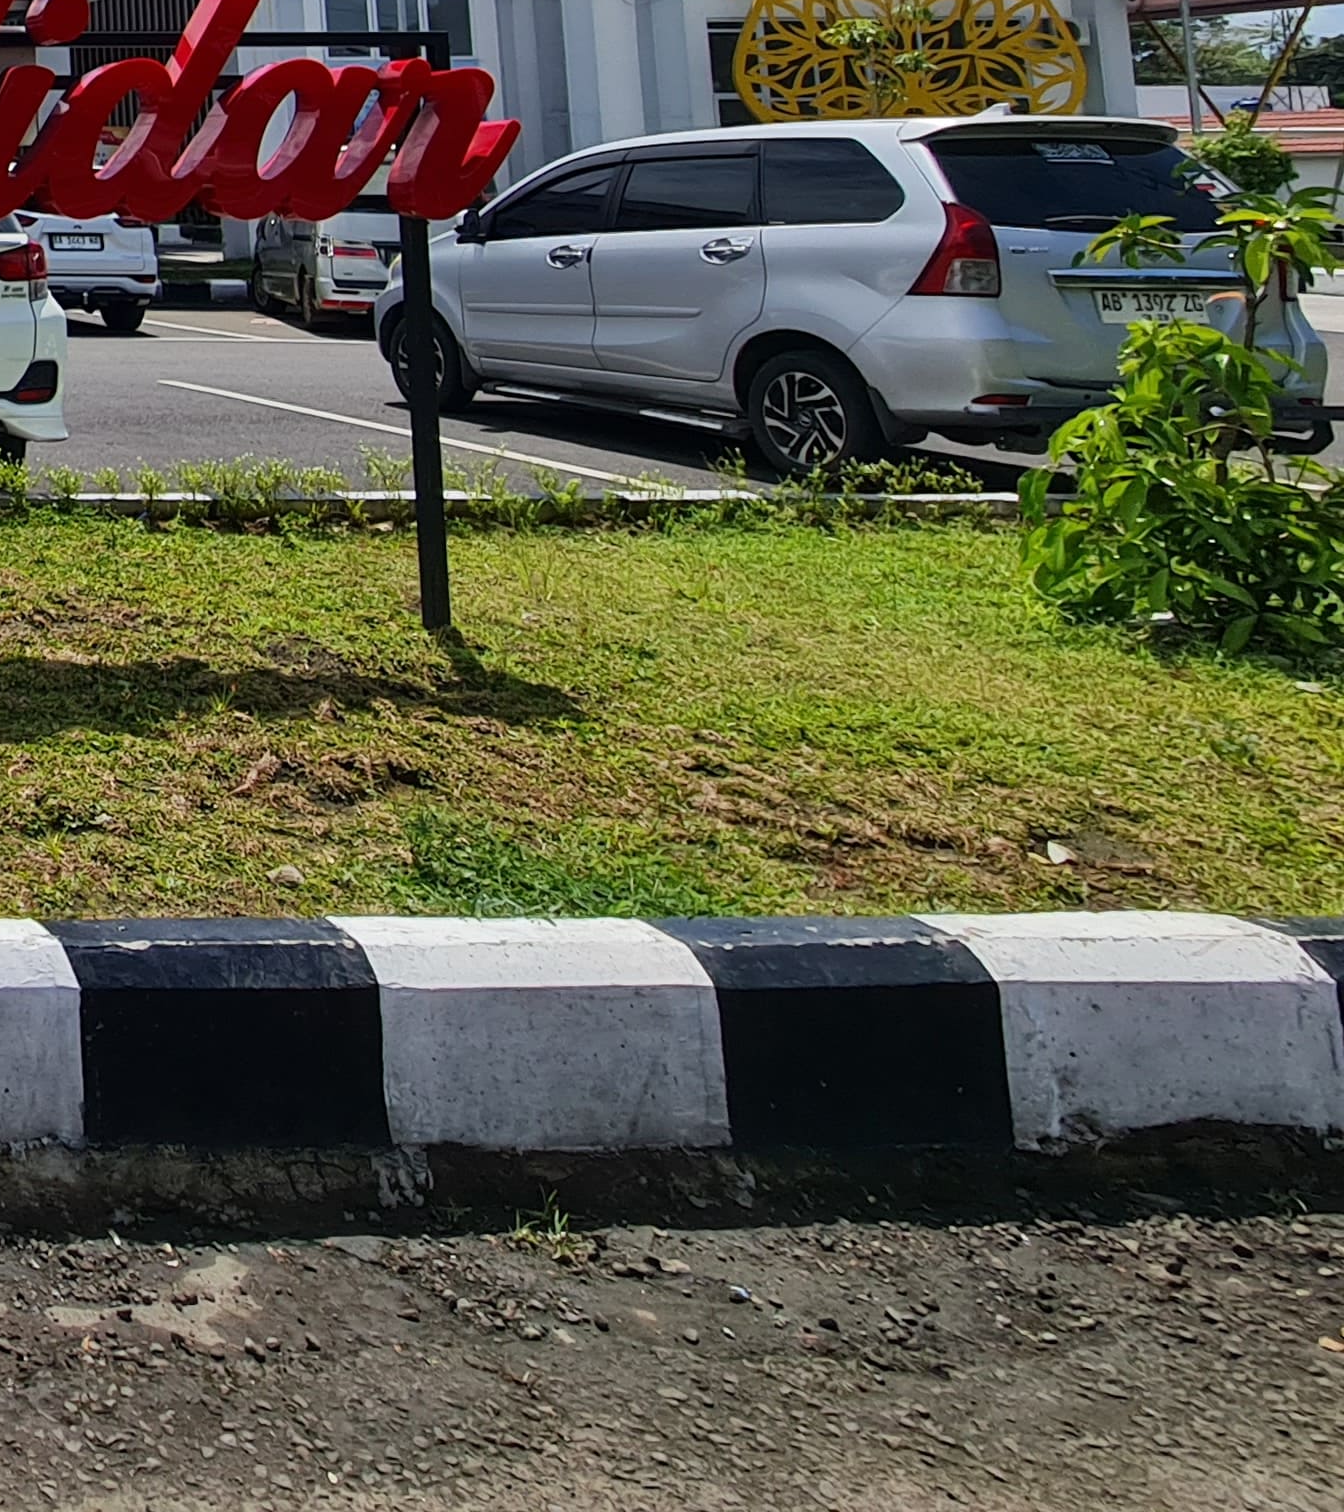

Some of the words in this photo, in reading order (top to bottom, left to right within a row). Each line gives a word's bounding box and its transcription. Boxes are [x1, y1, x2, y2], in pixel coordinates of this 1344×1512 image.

[1101, 293, 1123, 312] AB
[1131, 293, 1177, 312] 1392
[1180, 294, 1205, 312] ZG
